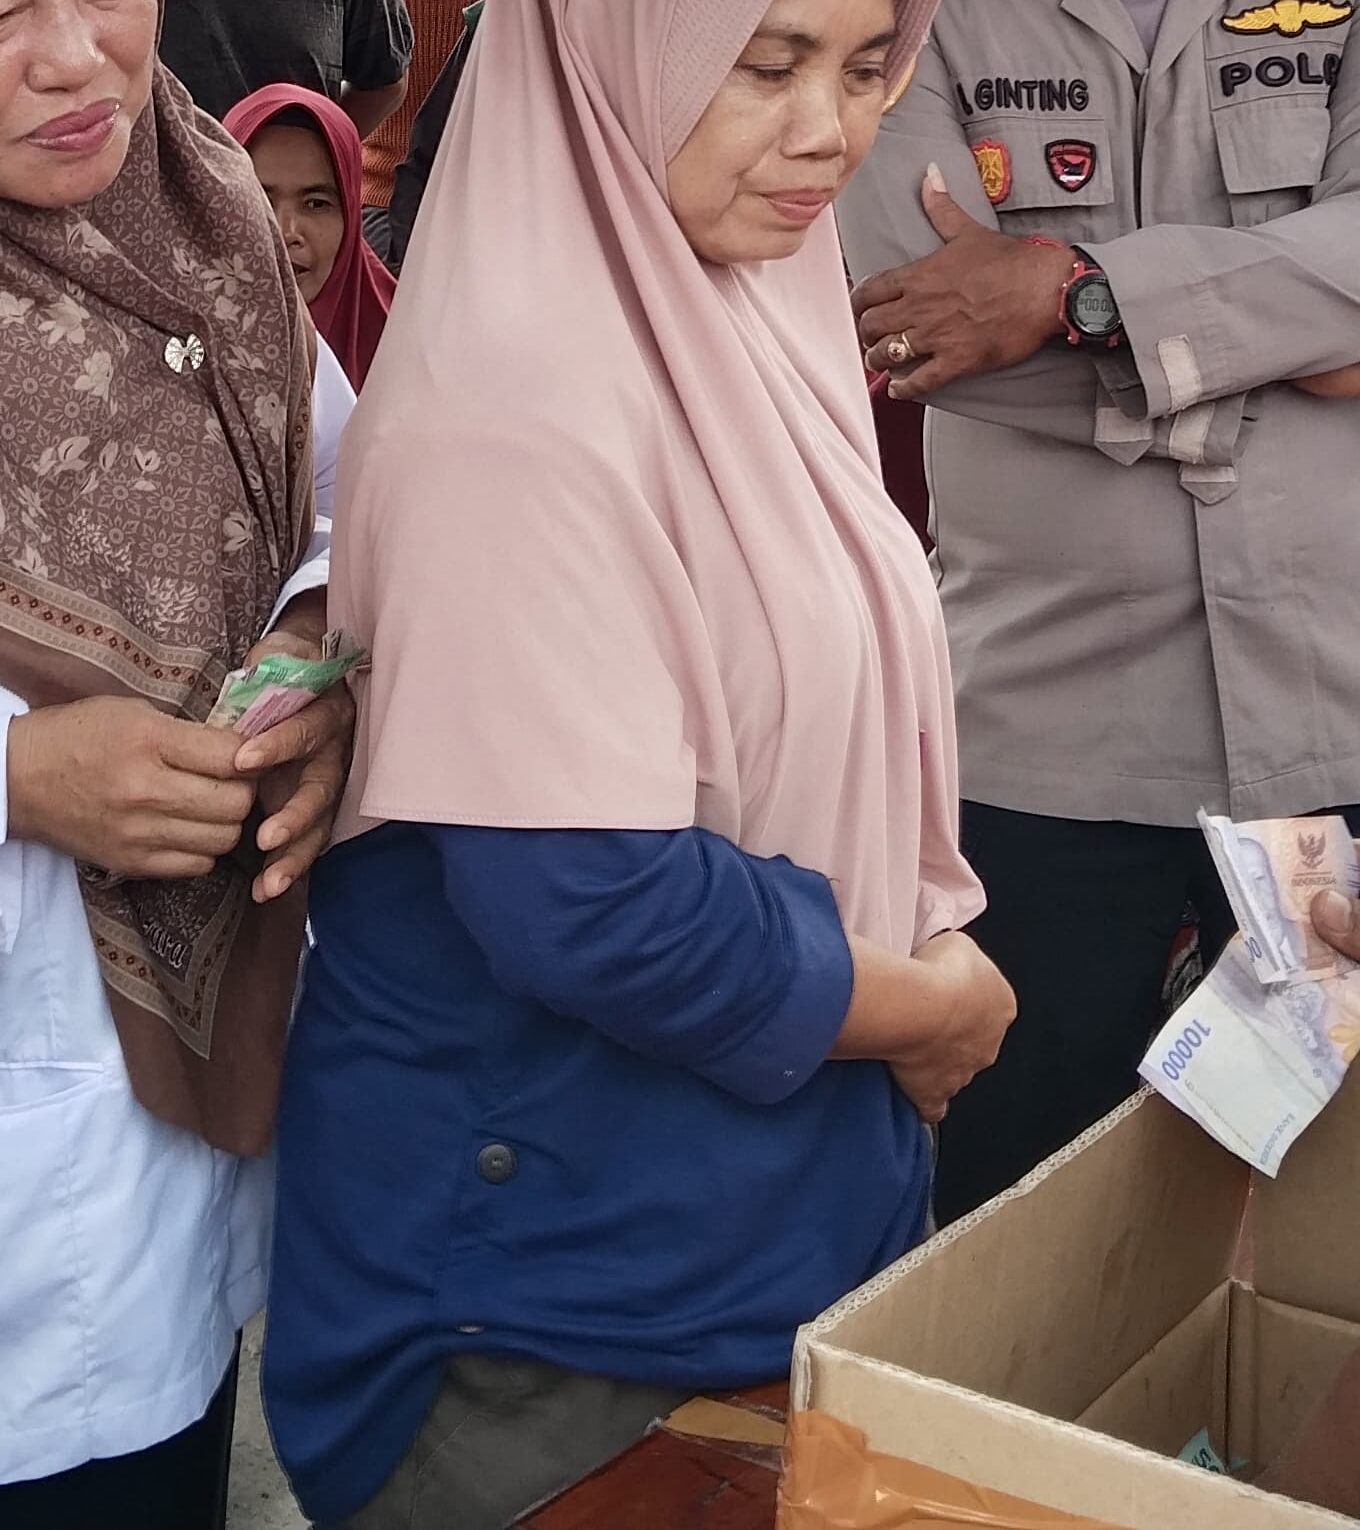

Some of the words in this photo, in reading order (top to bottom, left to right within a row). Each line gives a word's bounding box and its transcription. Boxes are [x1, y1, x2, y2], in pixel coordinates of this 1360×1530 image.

[974, 77, 1089, 111] GINTING
[1220, 52, 1340, 97] POLR
[1161, 1019, 1212, 1081] 10000
